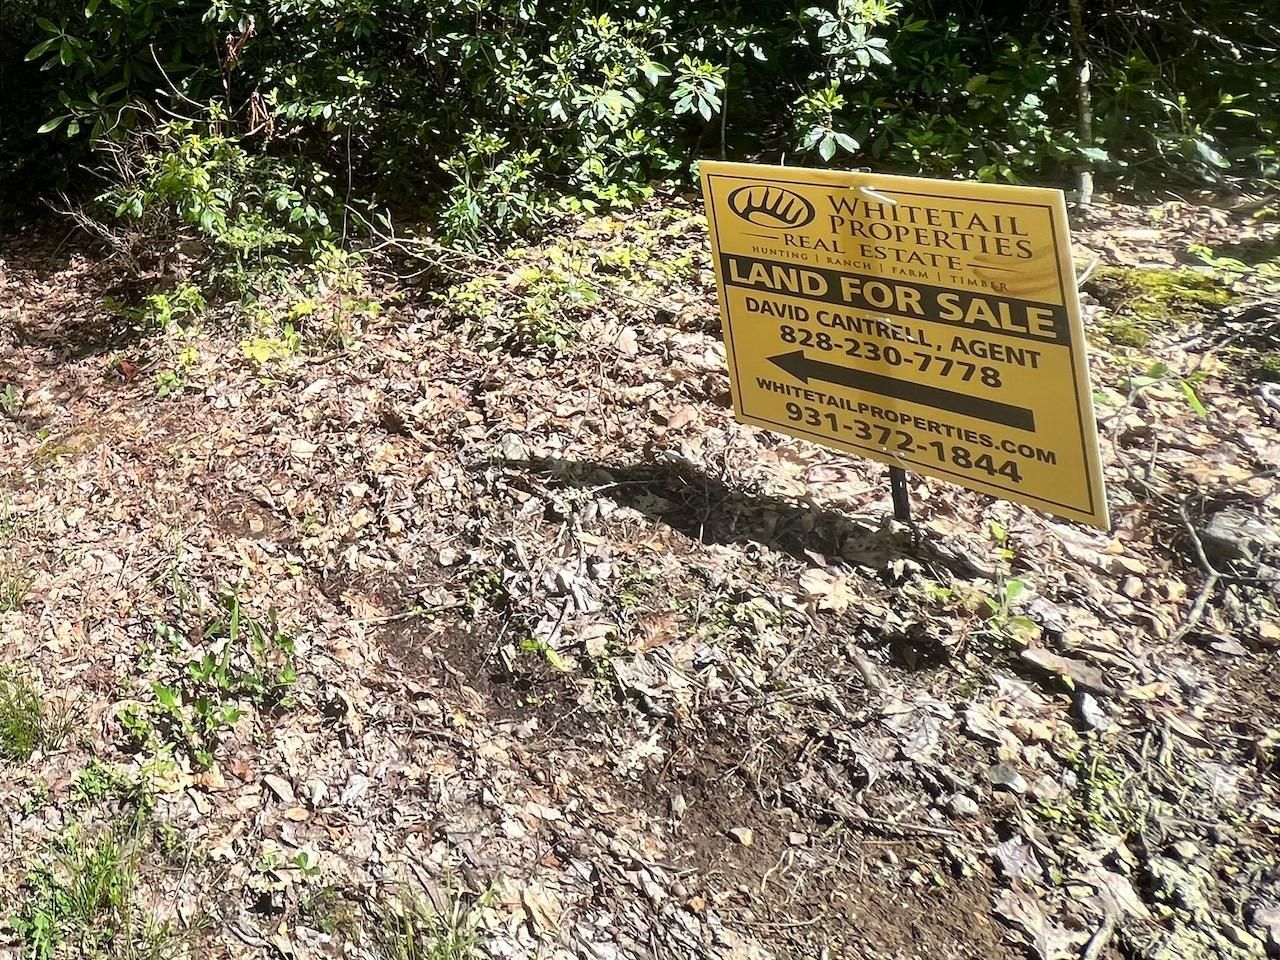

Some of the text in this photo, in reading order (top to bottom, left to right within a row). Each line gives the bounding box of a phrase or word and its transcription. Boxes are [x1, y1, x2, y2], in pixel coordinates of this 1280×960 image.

[827, 195, 1028, 237] WHITETAIL
[828, 215, 1033, 259] PROPERTIES
[752, 246, 1009, 291] HUNTING RANCH FARM TIMBER
[783, 233, 962, 271] REAL ESTATE
[728, 258, 1057, 339] LAND FOR SALE
[745, 297, 809, 322] DAVID
[951, 336, 1041, 369] AGENT
[780, 325, 1002, 388] 828-230-7778
[756, 377, 1056, 465] WHITETAILPROPERTIES.COM
[785, 402, 1022, 483] 931-372-1844
